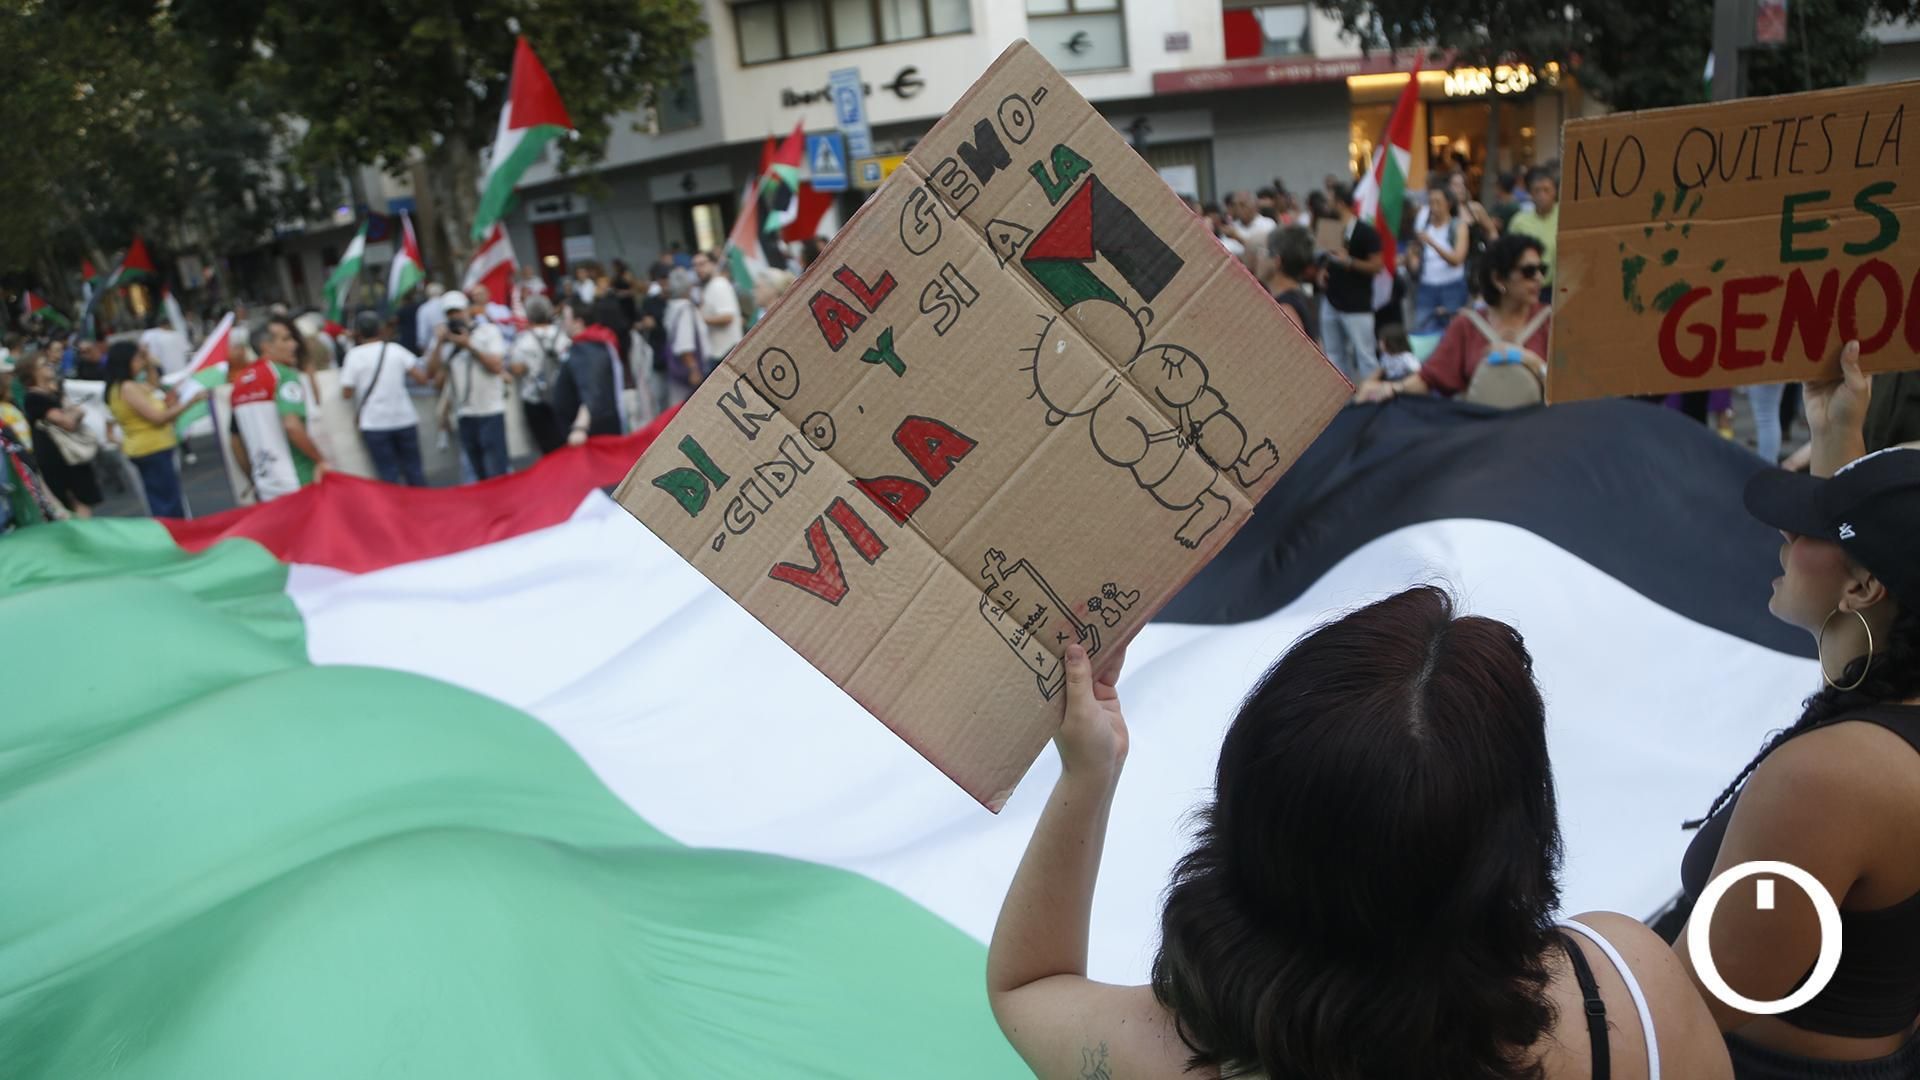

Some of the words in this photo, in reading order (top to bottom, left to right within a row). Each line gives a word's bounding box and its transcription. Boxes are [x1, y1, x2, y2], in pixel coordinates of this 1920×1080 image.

[1574, 134, 1646, 201] NO
[1673, 112, 1838, 191] QUITES
[1854, 103, 1905, 169] LA
[860, 325, 908, 378] Y
[919, 262, 981, 337] SI
[985, 218, 1034, 269] A
[1028, 143, 1093, 206] LA
[1779, 180, 1901, 264] ES
[1658, 257, 1920, 379] GENO
[651, 434, 731, 518] DI
[716, 347, 800, 440] NO
[808, 263, 899, 352] AL
[768, 415, 979, 607] VIDA
[1009, 603, 1048, 647] Libertad
